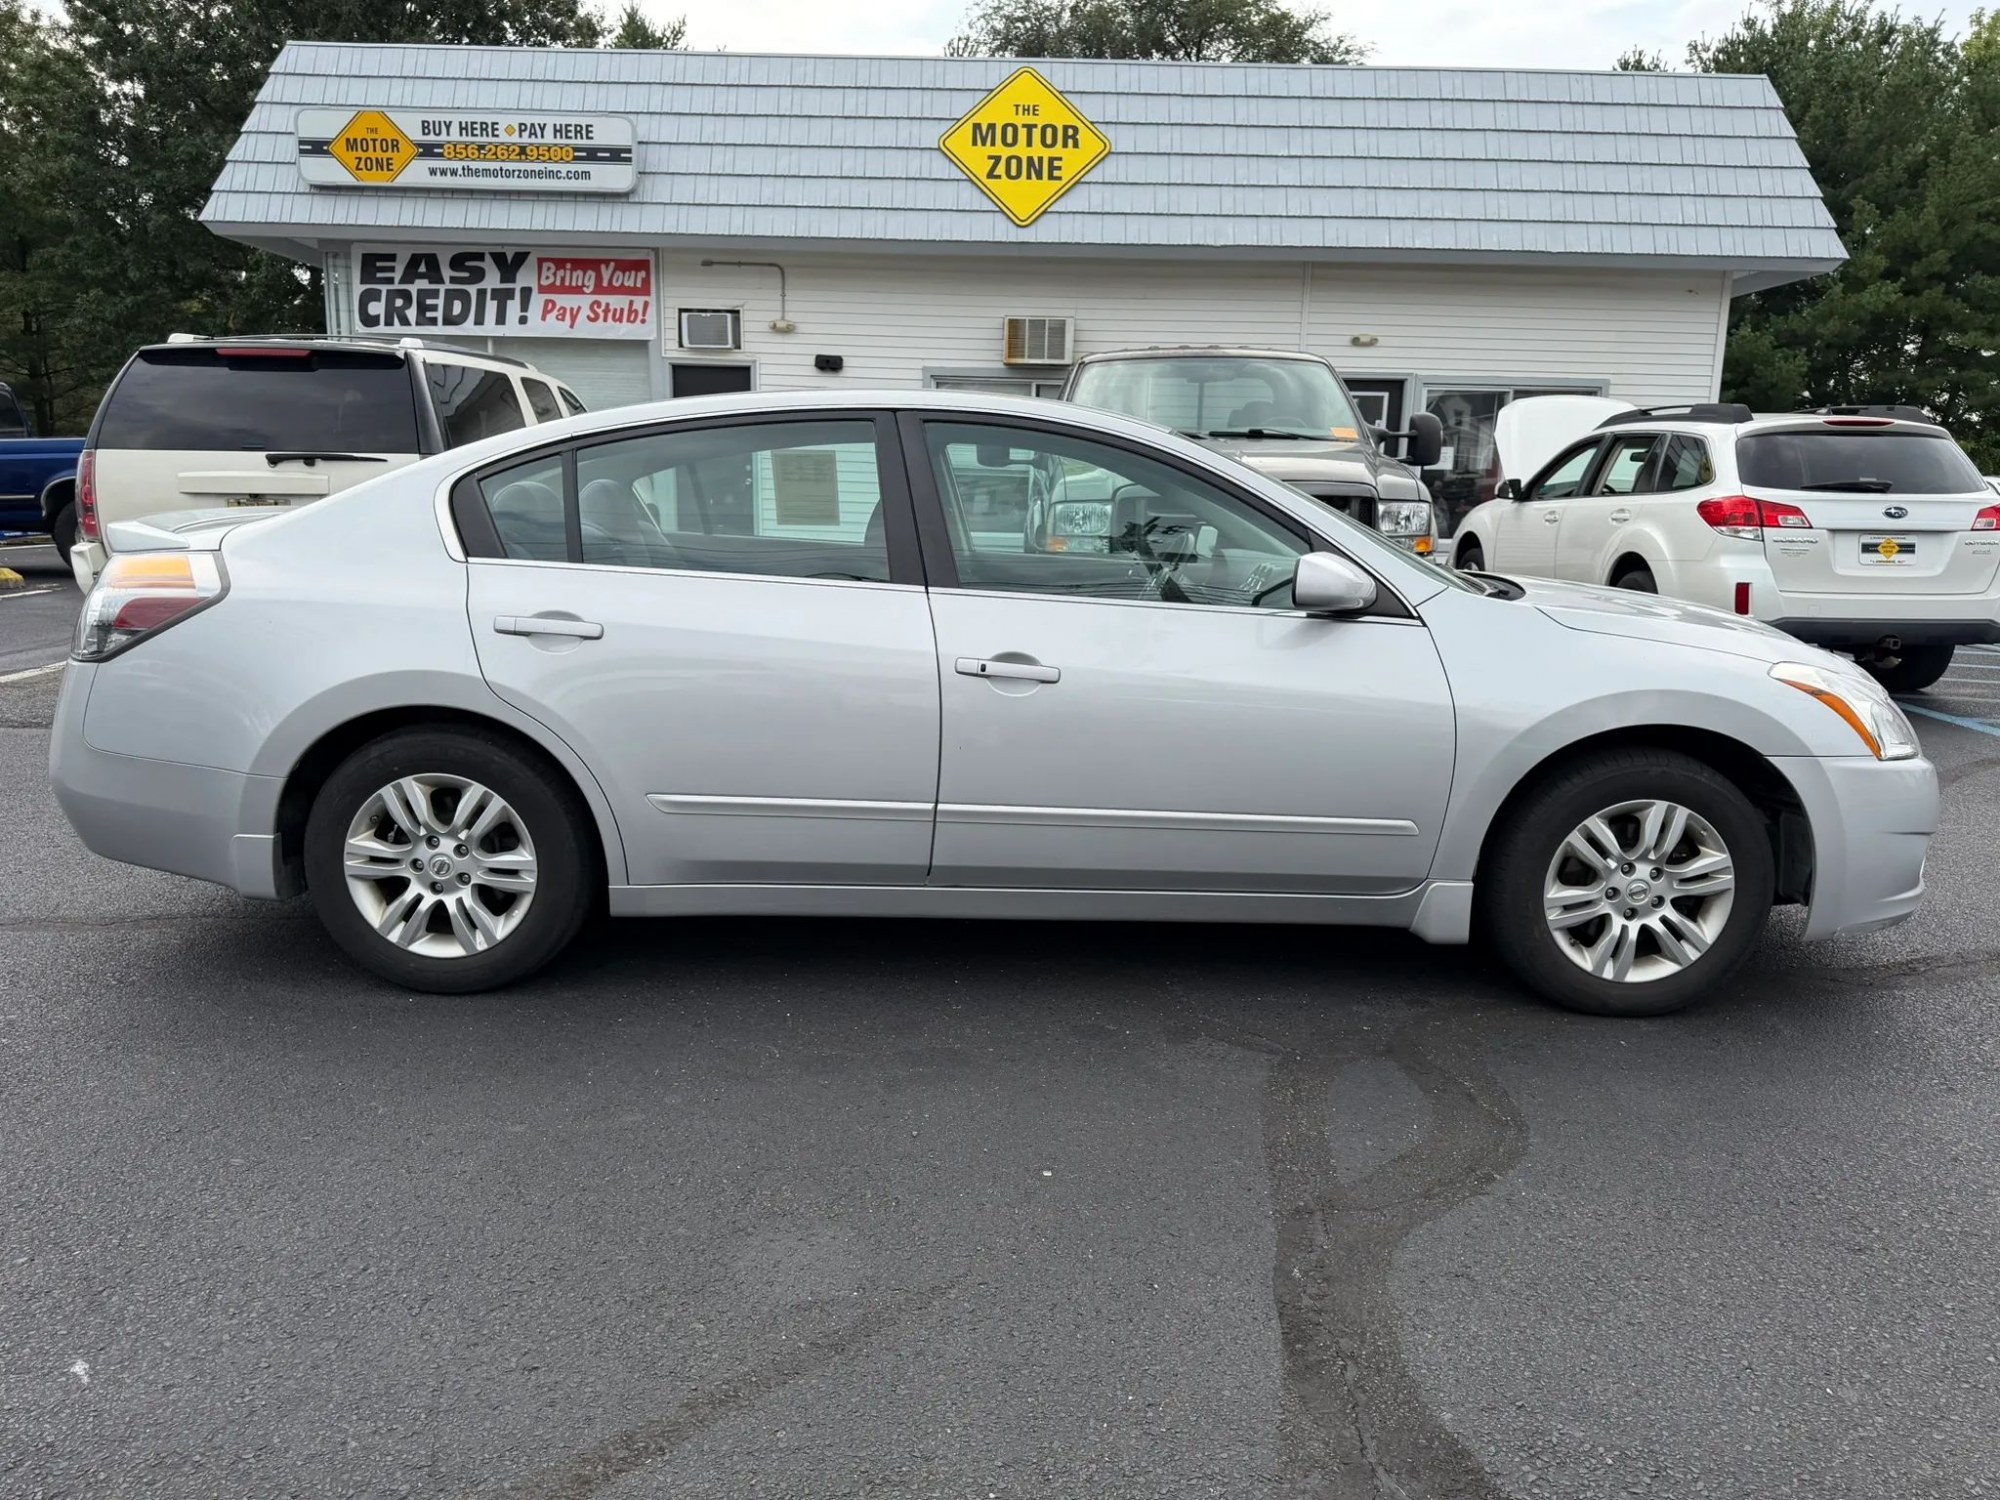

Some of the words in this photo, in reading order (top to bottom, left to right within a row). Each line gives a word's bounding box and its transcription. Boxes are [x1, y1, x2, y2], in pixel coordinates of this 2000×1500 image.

[1013, 104, 1040, 117] THE
[366, 127, 379, 135] THE
[420, 120, 453, 137] BUY
[458, 121, 500, 138] HERE
[518, 122, 547, 140] PAY
[552, 123, 594, 140] HERE
[971, 122, 1080, 149] MOTOR
[345, 138, 400, 153] MOTOR
[442, 143, 575, 162] 856.262.9500
[354, 156, 395, 172] ZONE
[428, 165, 591, 181] www.themotorzoneinc.com
[986, 155, 1063, 181] ZONE
[359, 251, 532, 285] EASY
[539, 261, 597, 293] Bring
[599, 264, 646, 289] Your
[357, 286, 534, 328] CREDIT!
[540, 298, 581, 330] Pay
[587, 300, 650, 325] Stub!
